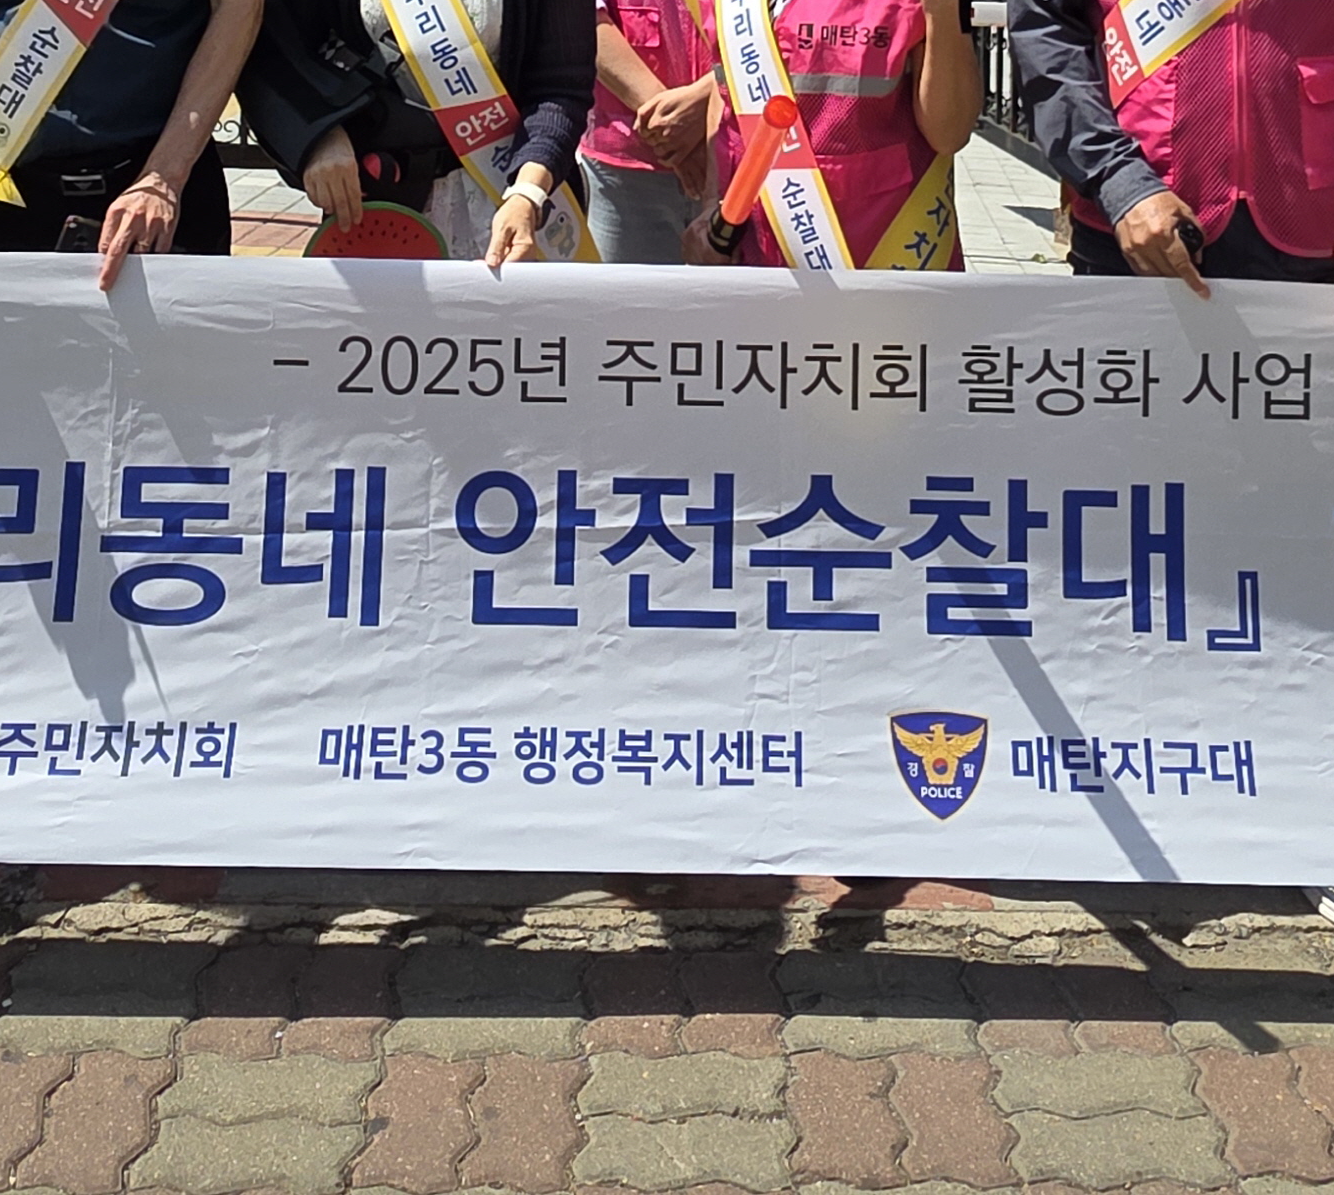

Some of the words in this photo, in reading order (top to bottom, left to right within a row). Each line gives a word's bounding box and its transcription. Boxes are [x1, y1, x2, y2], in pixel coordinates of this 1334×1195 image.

[820, 24, 889, 49] 매탄3동
[1102, 26, 1139, 87] 안전
[455, 100, 510, 142] 안전
[781, 176, 831, 271] 순찰대
[335, 334, 570, 404] 2025년
[596, 337, 930, 411] 주민자치회
[956, 341, 1160, 417] 활성화
[1181, 350, 1317, 420] 사업
[317, 723, 499, 785] 매탄3동
[512, 725, 806, 789] 행정복지센터
[1010, 735, 1258, 798] 매탄지구대
[920, 785, 964, 800] POLICE
